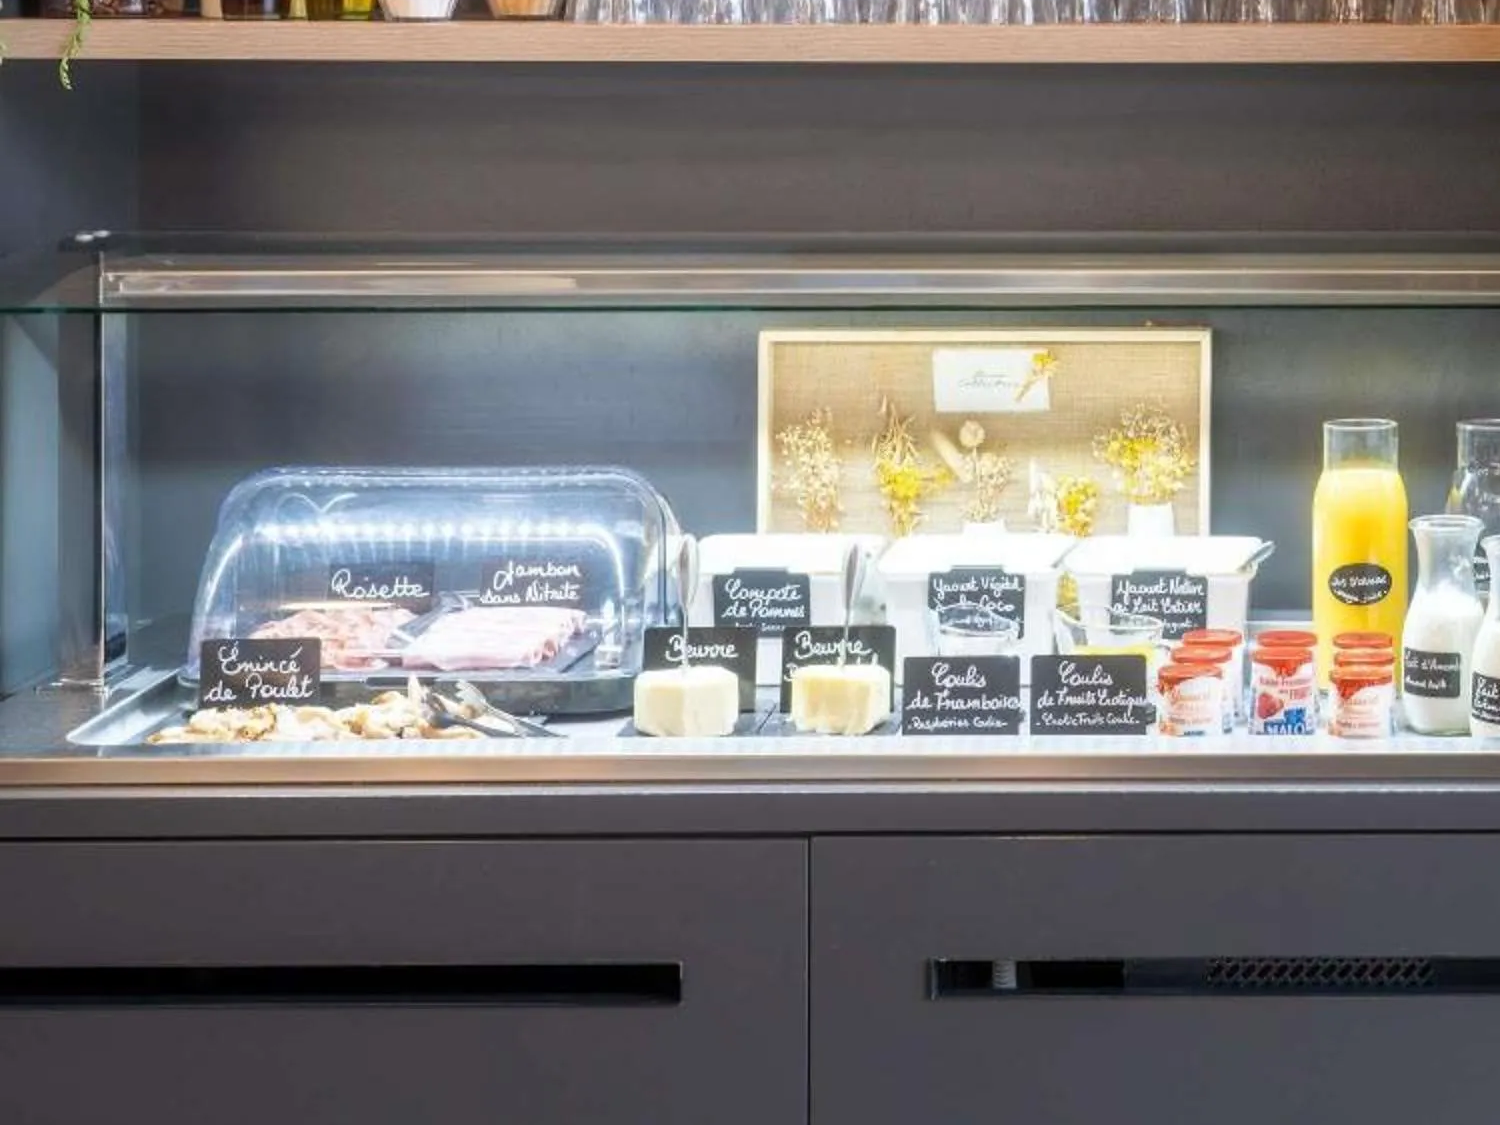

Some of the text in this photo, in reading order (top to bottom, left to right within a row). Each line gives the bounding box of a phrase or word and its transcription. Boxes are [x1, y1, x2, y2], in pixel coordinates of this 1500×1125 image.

[331, 568, 431, 600] Rosette
[493, 560, 581, 591] Jambon
[932, 577, 979, 600] Yaourt
[1115, 577, 1168, 604] Yaourt
[721, 599, 806, 619] de Pommes
[665, 634, 740, 662] Beurre
[794, 631, 873, 660] Beurre
[931, 662, 987, 688] Coulis
[1059, 660, 1114, 686] Coulis
[203, 672, 314, 702] de Poulet
[905, 690, 933, 710] de
[1037, 690, 1055, 710] de
